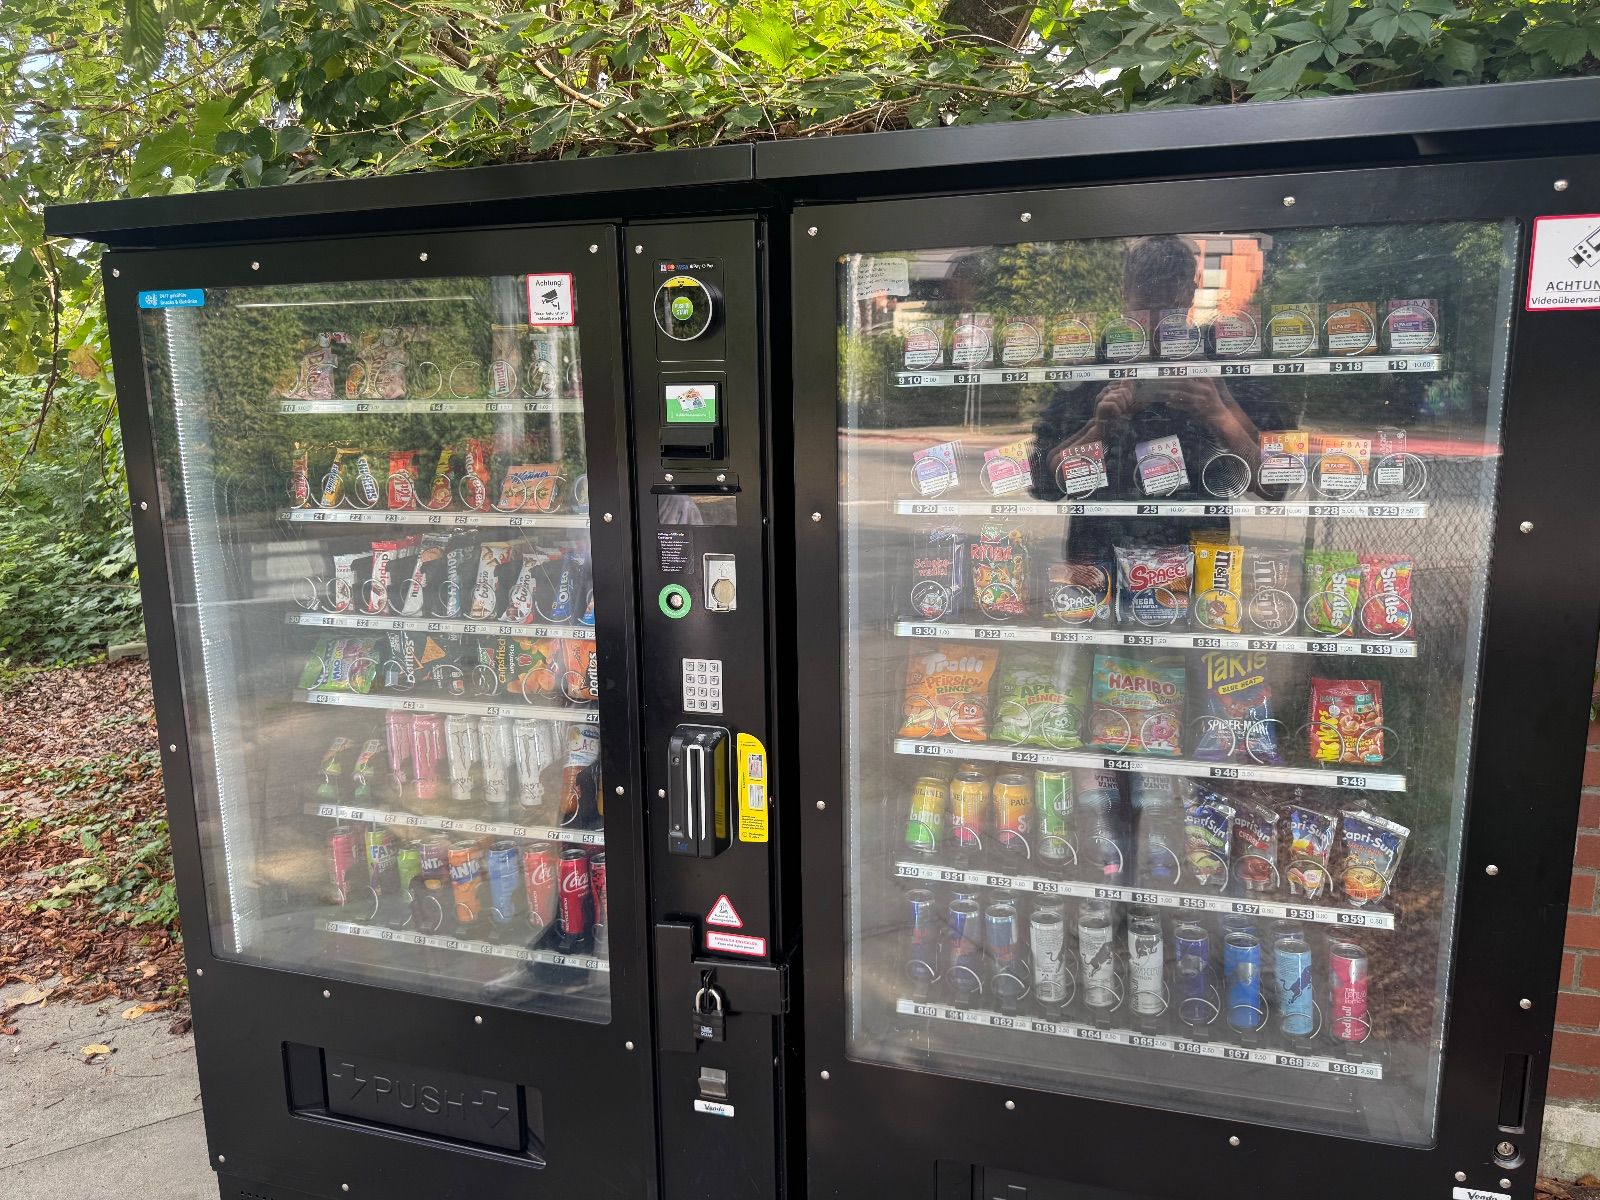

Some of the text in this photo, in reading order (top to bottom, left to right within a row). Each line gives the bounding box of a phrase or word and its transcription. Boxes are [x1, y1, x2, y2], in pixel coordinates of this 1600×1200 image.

[1531, 296, 1600, 304] Videoüberwac
[1279, 364, 1302, 372] 917
[1335, 362, 1362, 371] 918
[1391, 361, 1407, 369] 19
[1114, 369, 1136, 377] 914
[1164, 367, 1186, 376] 915
[1225, 366, 1250, 374] 916
[1006, 373, 1027, 381] 912
[1050, 372, 1072, 380] 913
[899, 376, 921, 385] 910
[916, 505, 936, 513] 920
[1061, 505, 1083, 513] 923
[1260, 507, 1284, 515] 927
[1314, 507, 1338, 515] 928
[1374, 508, 1398, 516] 929
[1381, 567, 1397, 624] Skittles
[1332, 573, 1347, 627] Skittles
[916, 627, 935, 635] 930
[980, 630, 999, 638] 932
[1056, 633, 1077, 641] 933
[1198, 639, 1219, 647] 936
[589, 652, 598, 696] Doritos
[1109, 673, 1176, 696] HARIBO
[1222, 678, 1257, 693] BLUE HEAT
[1208, 719, 1269, 735] SPIDER-MAN
[1215, 769, 1237, 777] 946
[1342, 778, 1365, 786] 948
[991, 878, 1010, 886] 952
[1037, 883, 1057, 891] 953
[1136, 894, 1156, 902] 955
[1184, 899, 1204, 907] 956
[1291, 910, 1313, 918] 958
[1342, 915, 1364, 923] 959
[918, 1007, 935, 1015] 960
[994, 1018, 1013, 1026] 962
[1036, 1024, 1054, 1032] 963
[1229, 1050, 1248, 1058] 967
[1281, 1057, 1302, 1066] 968
[1334, 1064, 1356, 1073] 969
[374, 1075, 466, 1120] PUSH
